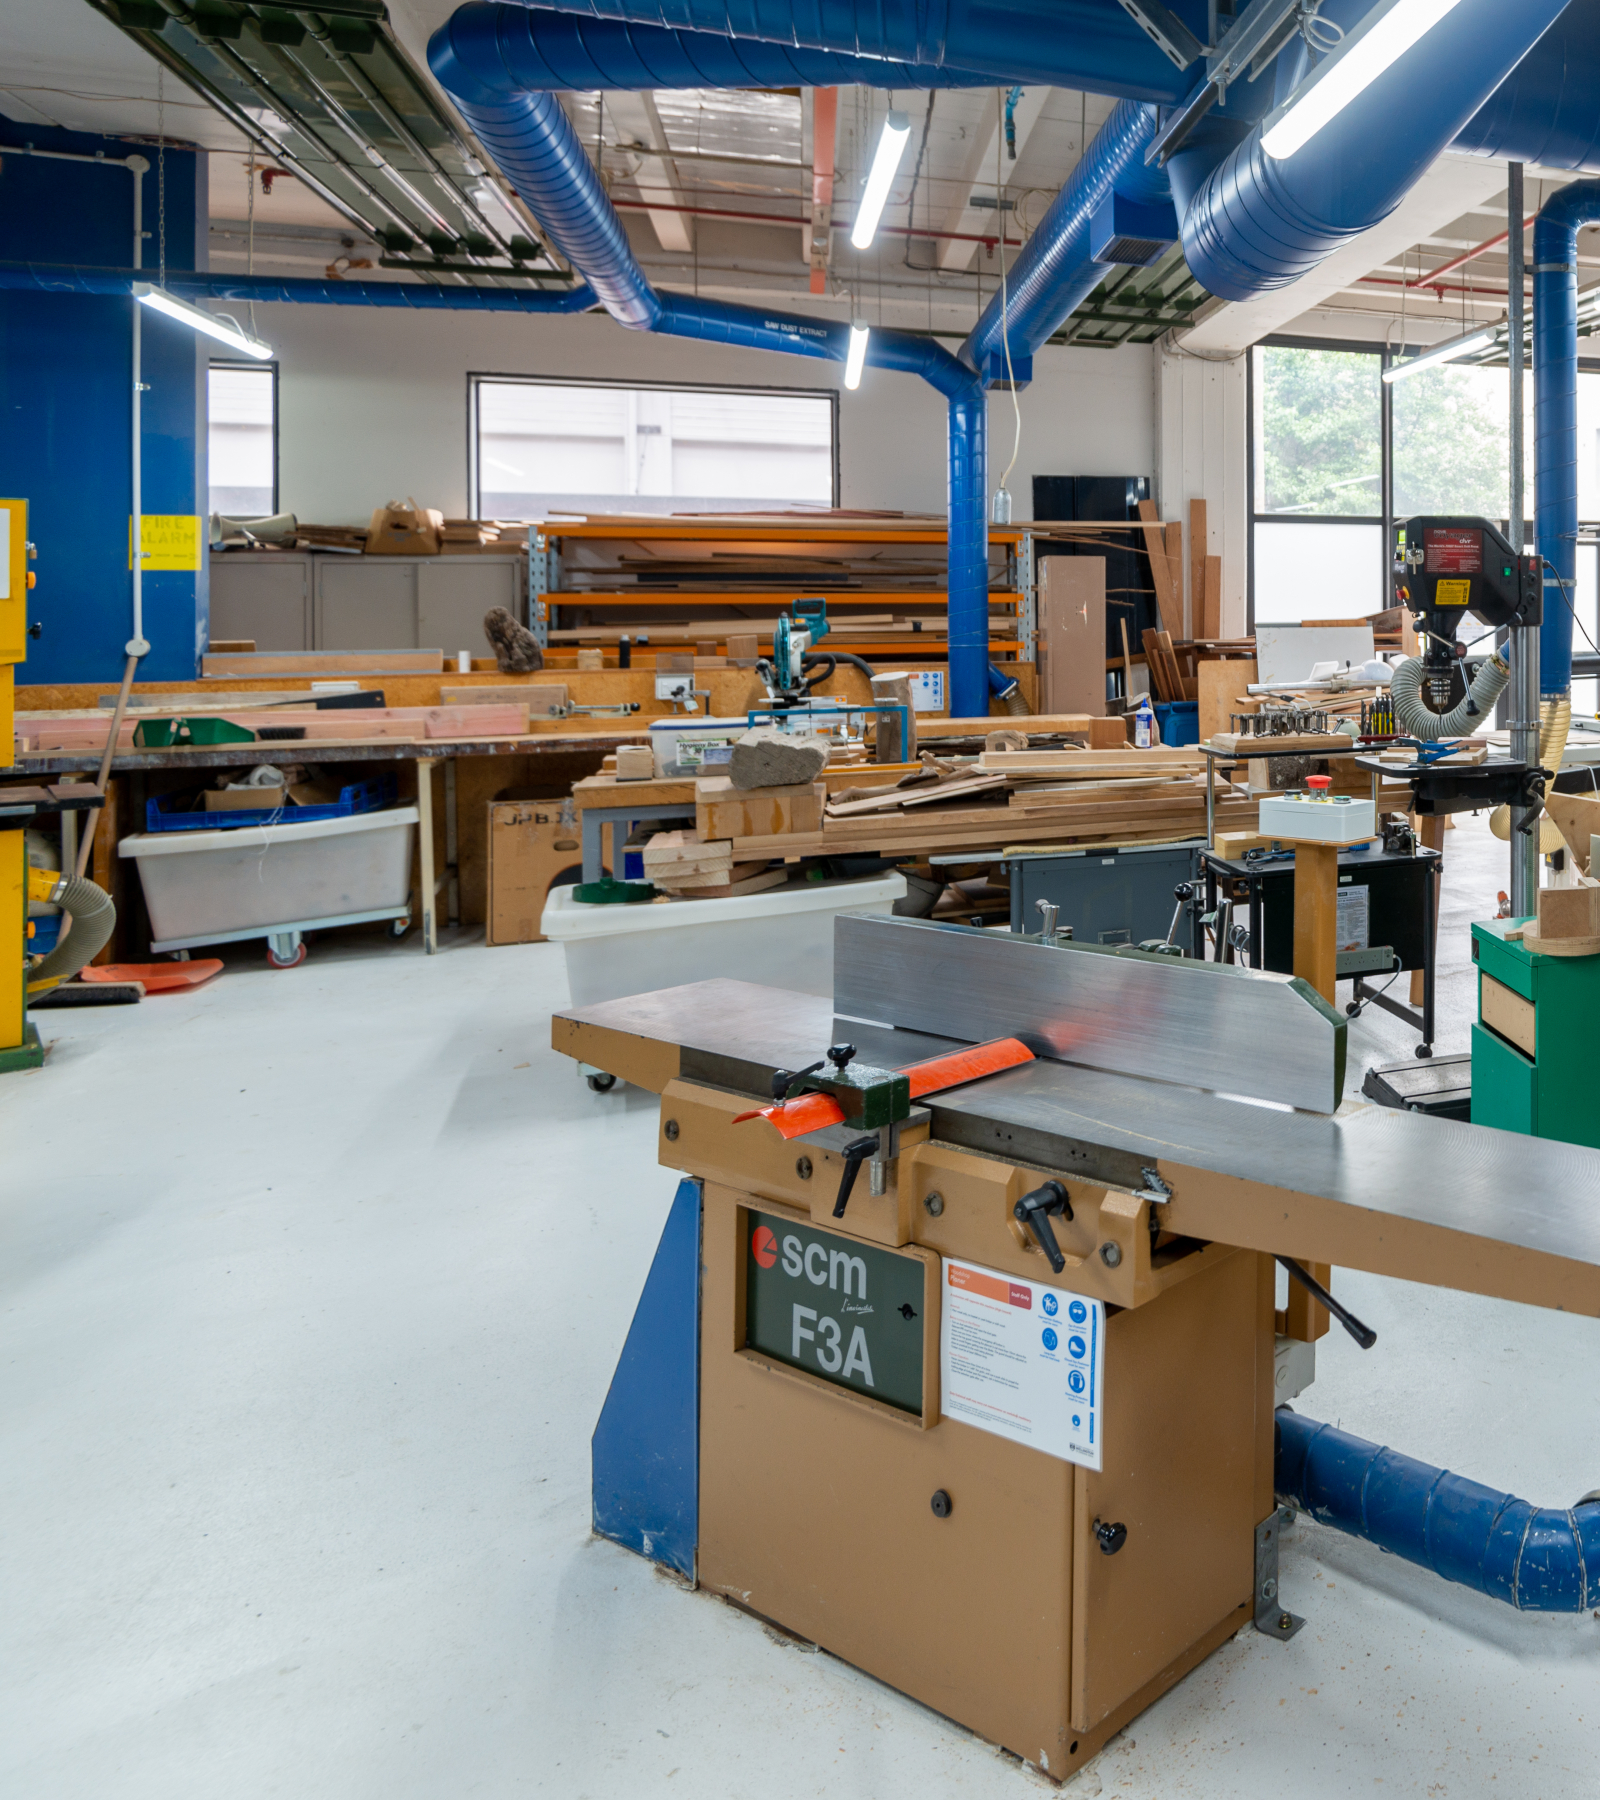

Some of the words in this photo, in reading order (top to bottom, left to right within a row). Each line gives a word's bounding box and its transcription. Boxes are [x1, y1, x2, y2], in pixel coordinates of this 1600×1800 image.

[764, 320, 779, 330] SAW
[781, 323, 798, 332] DUST
[800, 326, 828, 337] EXTRACT
[143, 516, 184, 530] FIRE
[781, 1234, 866, 1300] scm
[950, 1274, 966, 1285] Planer
[792, 1302, 875, 1387] F3A
